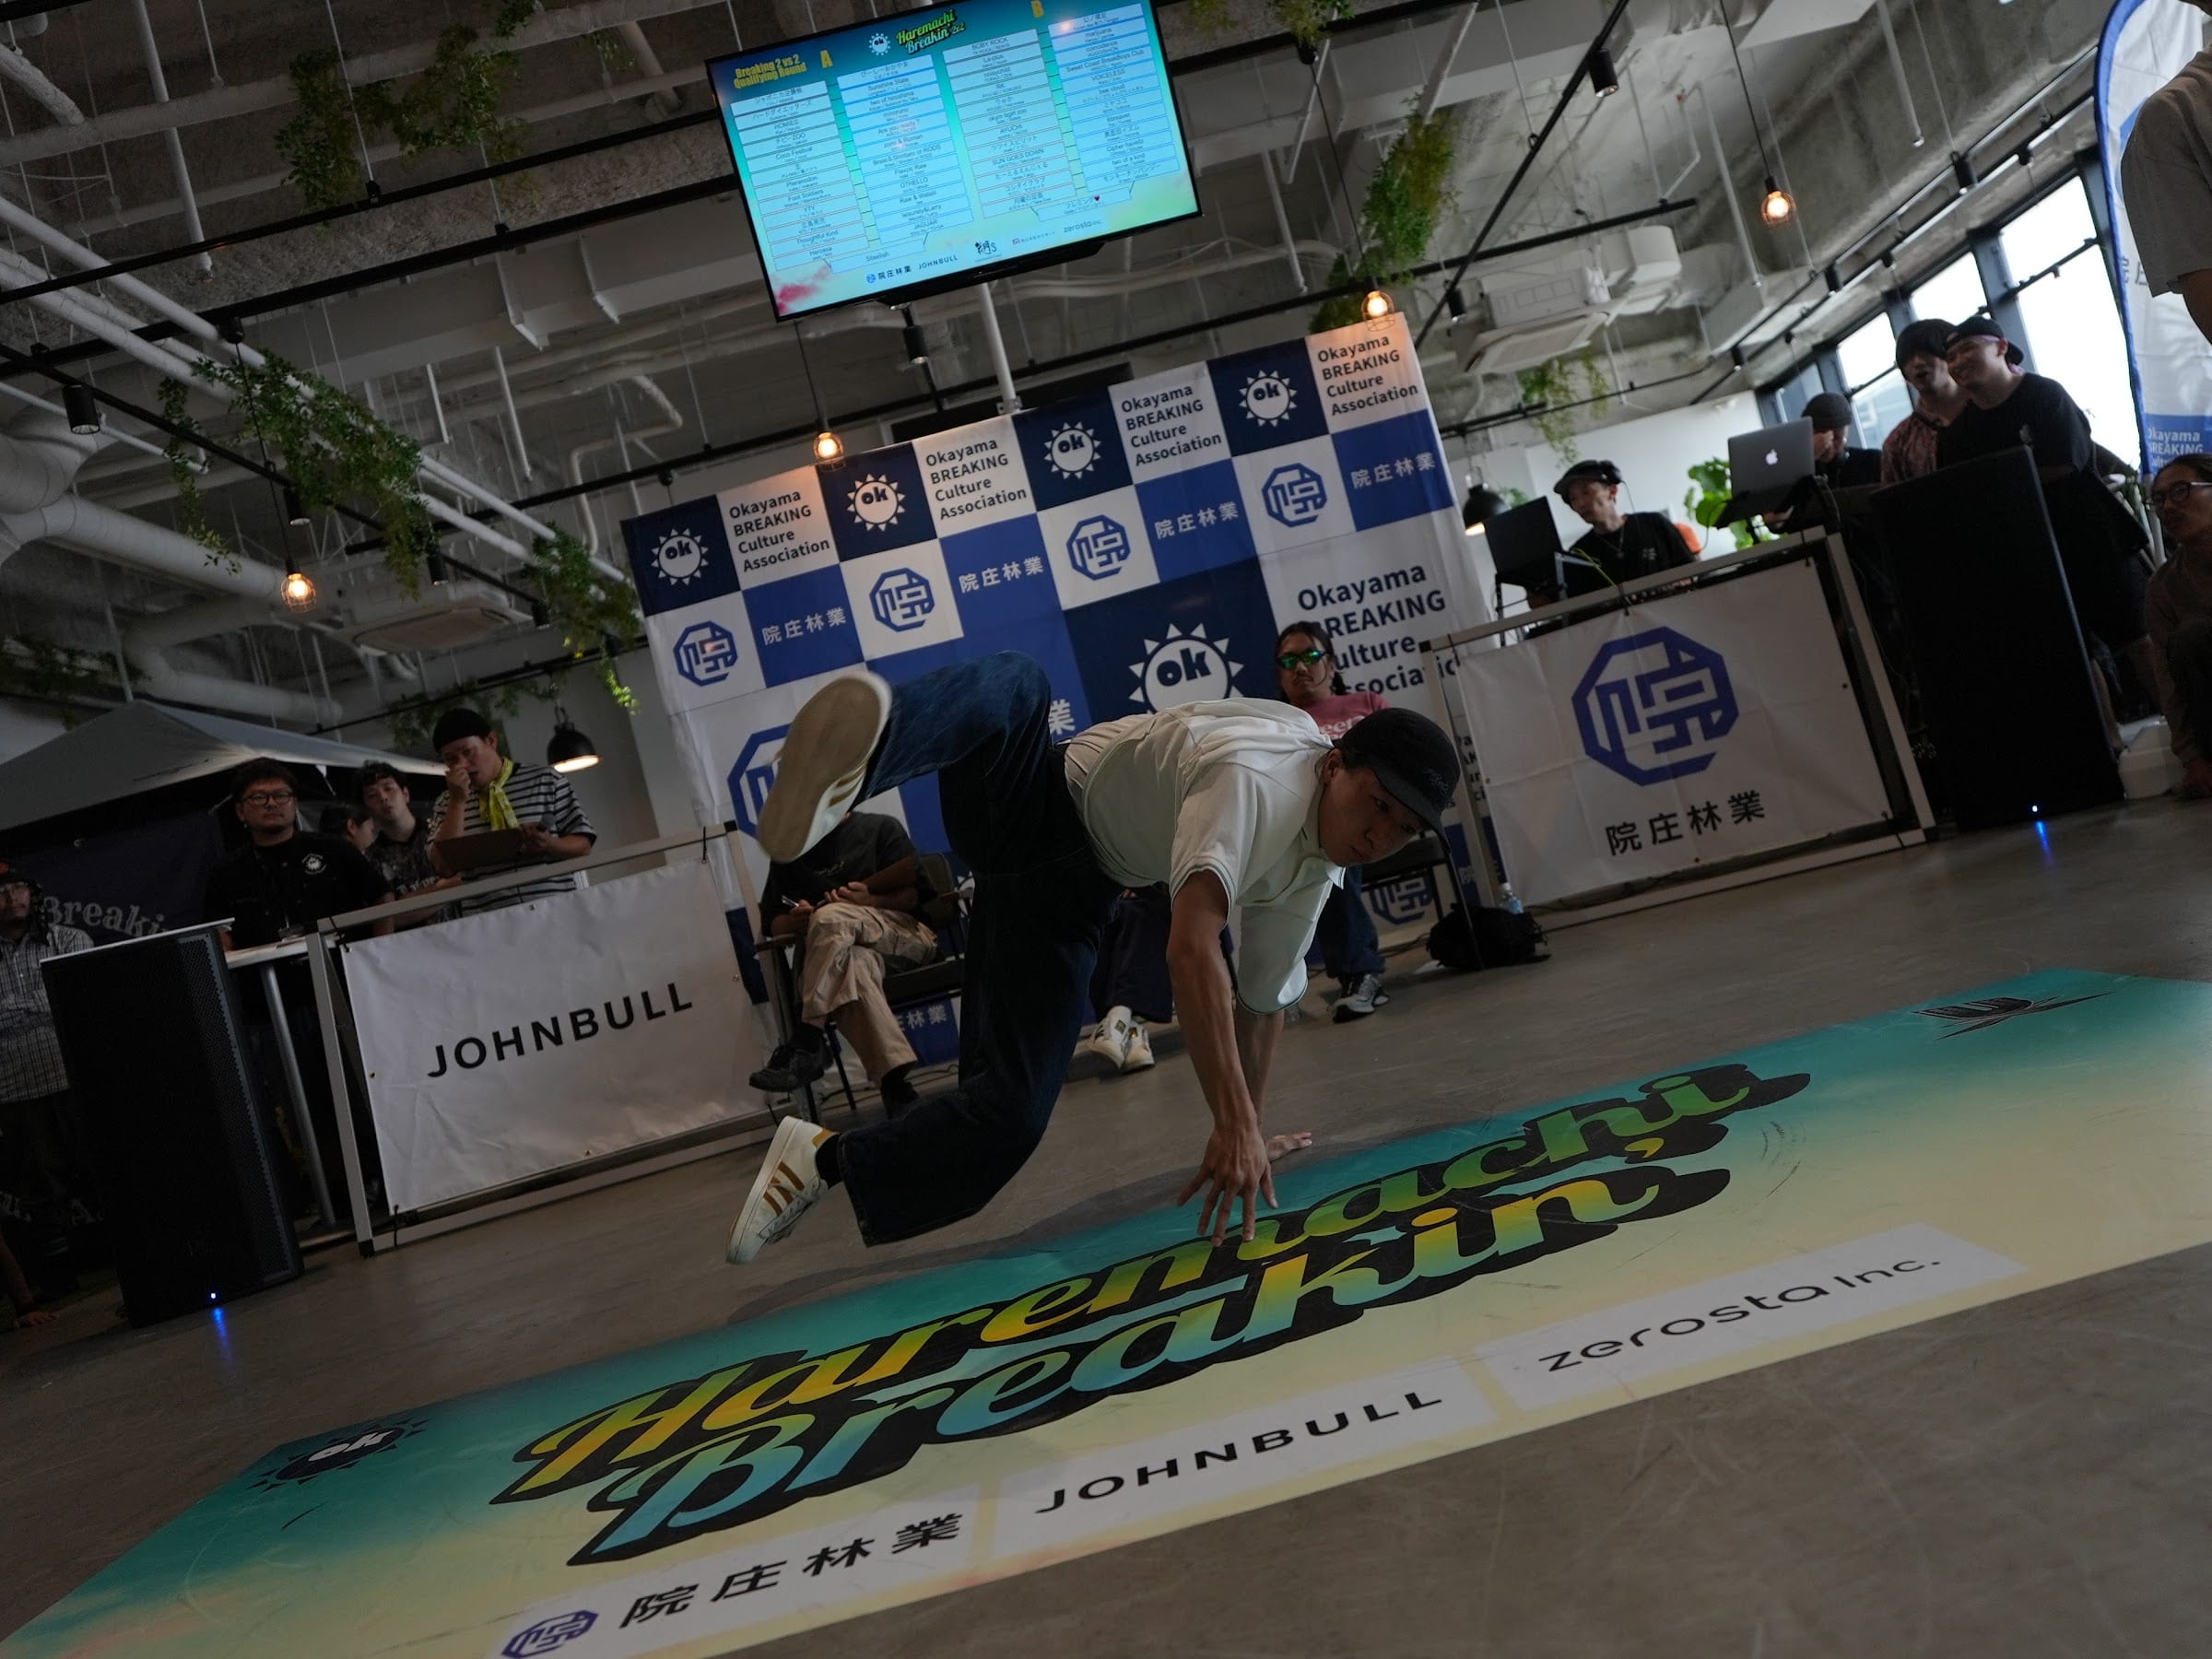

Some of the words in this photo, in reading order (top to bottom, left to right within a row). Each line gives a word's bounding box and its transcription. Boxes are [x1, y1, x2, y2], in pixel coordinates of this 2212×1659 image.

[896, 10, 955, 44] Haremachi
[735, 62, 775, 78] Breaking
[775, 58, 782, 69] 2
[782, 56, 792, 67] vs
[792, 53, 800, 65] 2
[820, 50, 833, 68] A
[734, 71, 779, 89] Qualifying
[779, 62, 807, 77] Round
[877, 265, 912, 280] 院庄林業
[919, 254, 959, 270] JOHNBULL
[1318, 336, 1389, 362] Okayama
[1323, 349, 1400, 380] BREAKING
[1122, 386, 1193, 413] Okayama
[1253, 382, 1280, 401] ok
[1327, 375, 1383, 397] Culture
[1332, 384, 1418, 416] Association
[1126, 400, 1204, 430] BREAKING
[1057, 433, 1085, 453] ok
[1131, 425, 1187, 447] Culture
[1135, 434, 1222, 466] Association
[2148, 441, 2205, 456] REAKING
[926, 440, 997, 466] Okayama
[931, 453, 1008, 484] BREAKING
[1351, 453, 1435, 489] 院庄林業
[729, 490, 801, 518] Okayama
[861, 487, 888, 505] ok
[935, 478, 992, 501] Culture
[940, 488, 1027, 520] Association
[735, 505, 811, 536] BREAKING
[1155, 501, 1240, 539] 院庄林業
[665, 539, 692, 560] ok
[738, 530, 794, 553] Culture
[743, 538, 830, 571] Association
[959, 556, 1043, 594] 院庄林業
[1298, 565, 1427, 611] Okayama
[761, 607, 846, 645] 院庄林業
[1322, 589, 1446, 640] REAKING
[1156, 647, 1211, 687] ok
[1333, 635, 1418, 671] ulture
[1606, 791, 1767, 857] 院庄林業
[42, 896, 170, 936] Breaki
[427, 982, 692, 1078] JOHNBULL
[502, 1067, 1760, 1500] Haremachi
[1538, 1284, 1830, 1372] zerosta
[1036, 1389, 1443, 1515] JOHNBULL
[618, 1512, 964, 1629] 院庄林業
